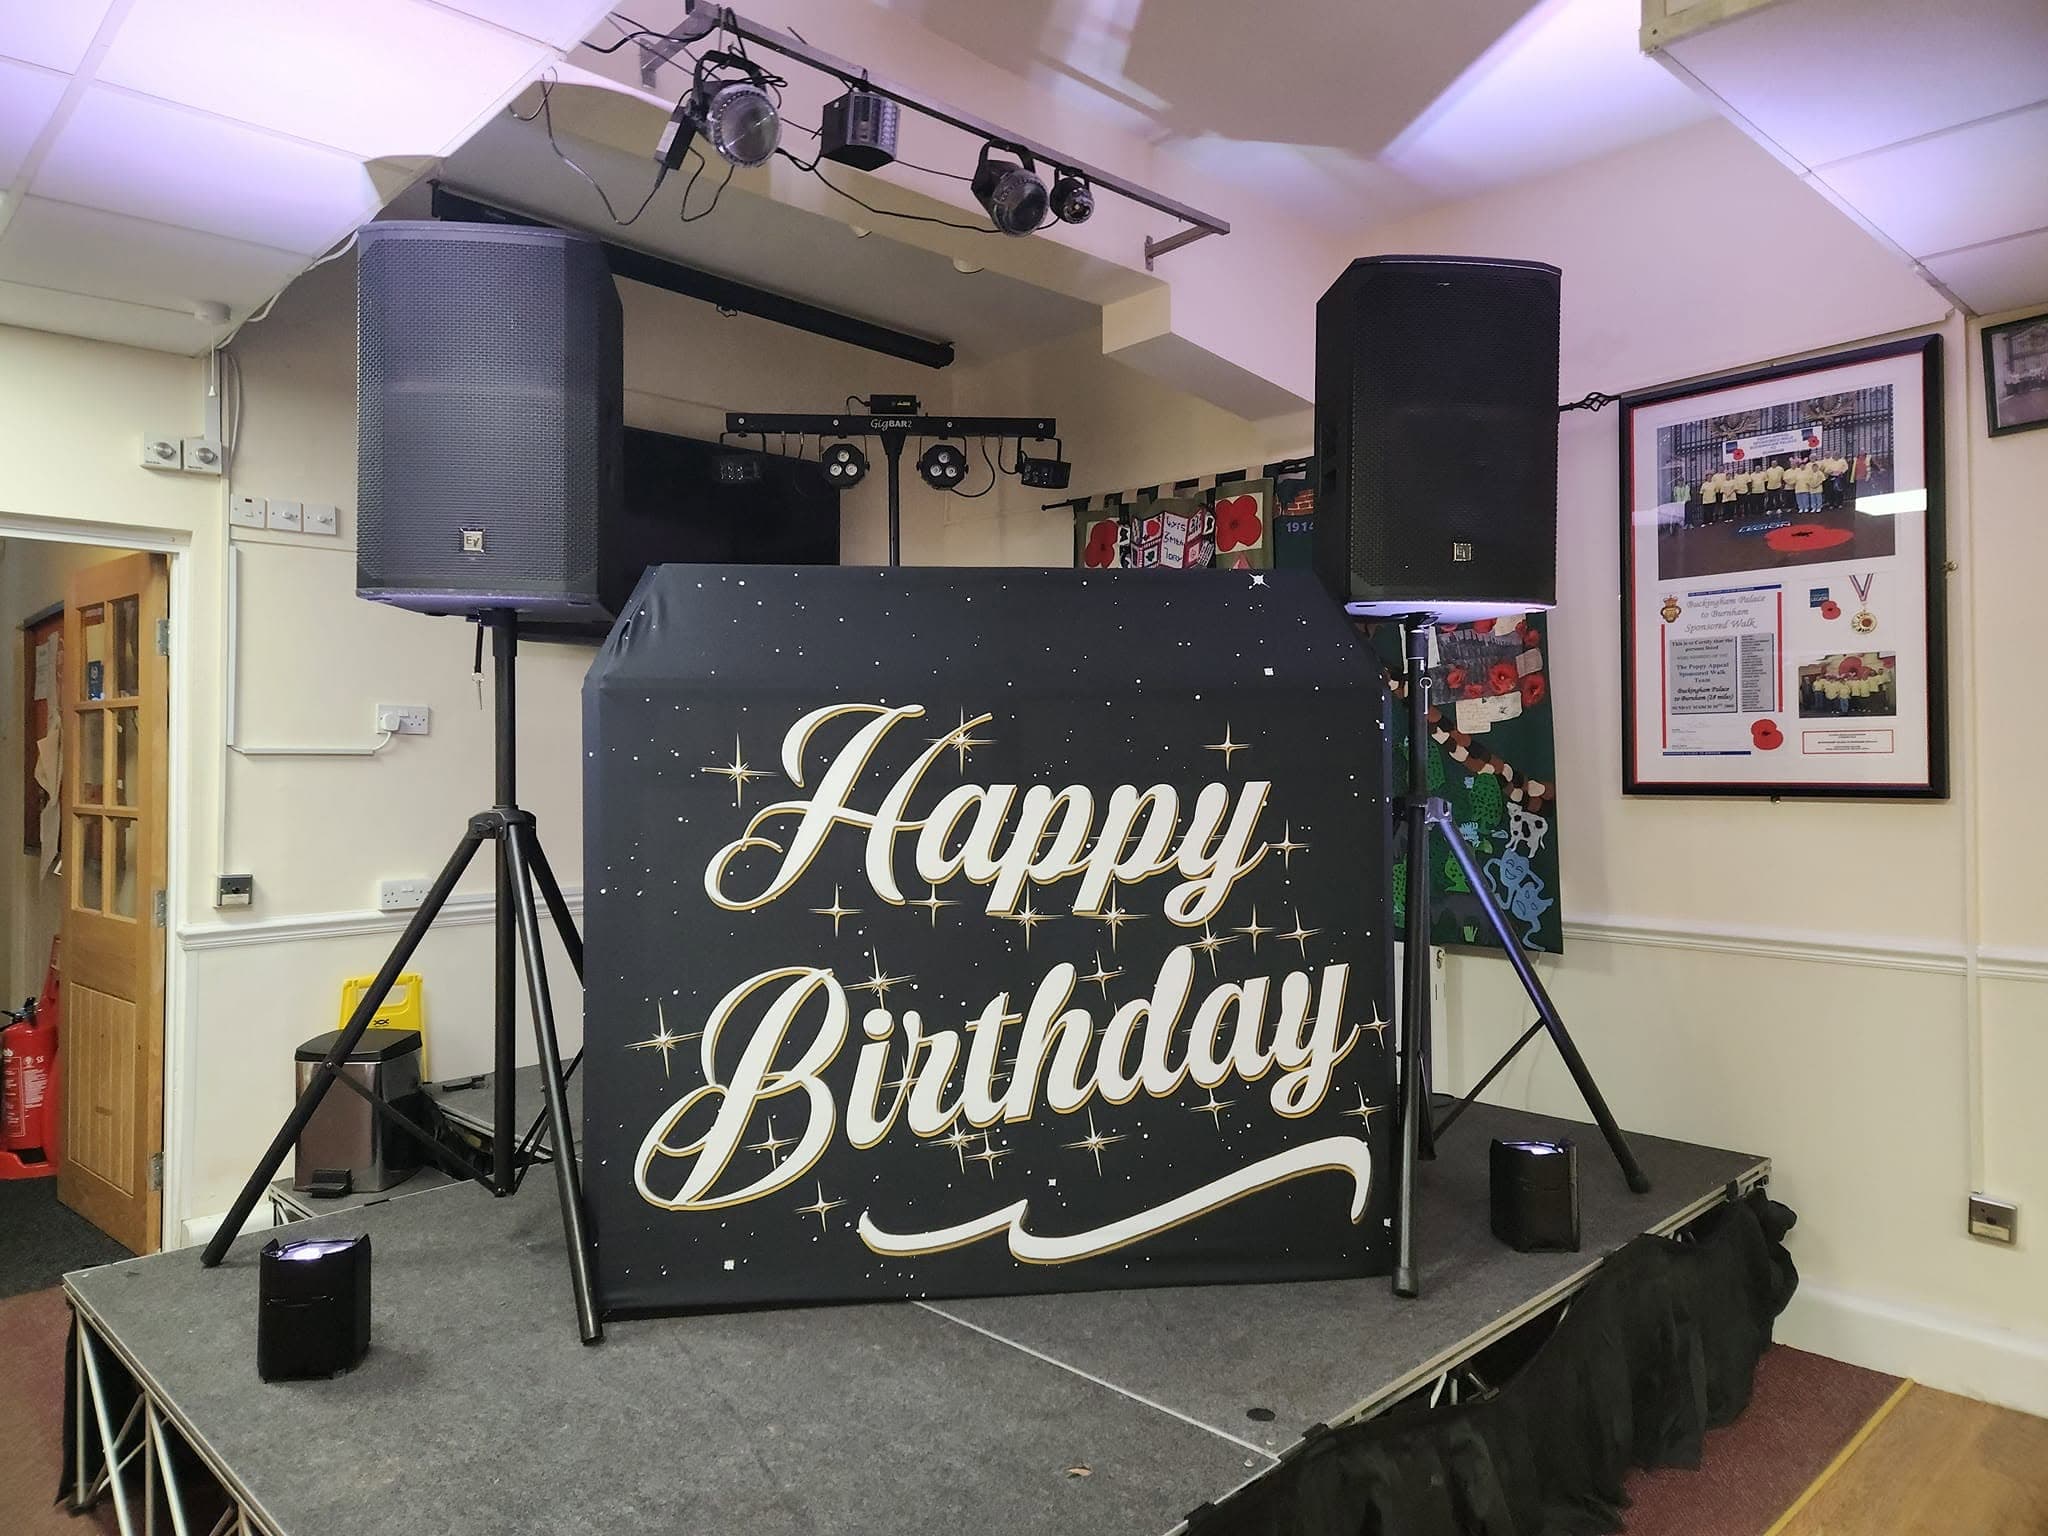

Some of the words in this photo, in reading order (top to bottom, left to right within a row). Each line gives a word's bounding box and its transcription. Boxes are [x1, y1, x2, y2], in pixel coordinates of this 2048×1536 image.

[1685, 620, 1728, 634] Sponsored
[1730, 617, 1758, 629] Walk
[704, 703, 1271, 927] Happy
[634, 946, 1359, 1211] Birthday
